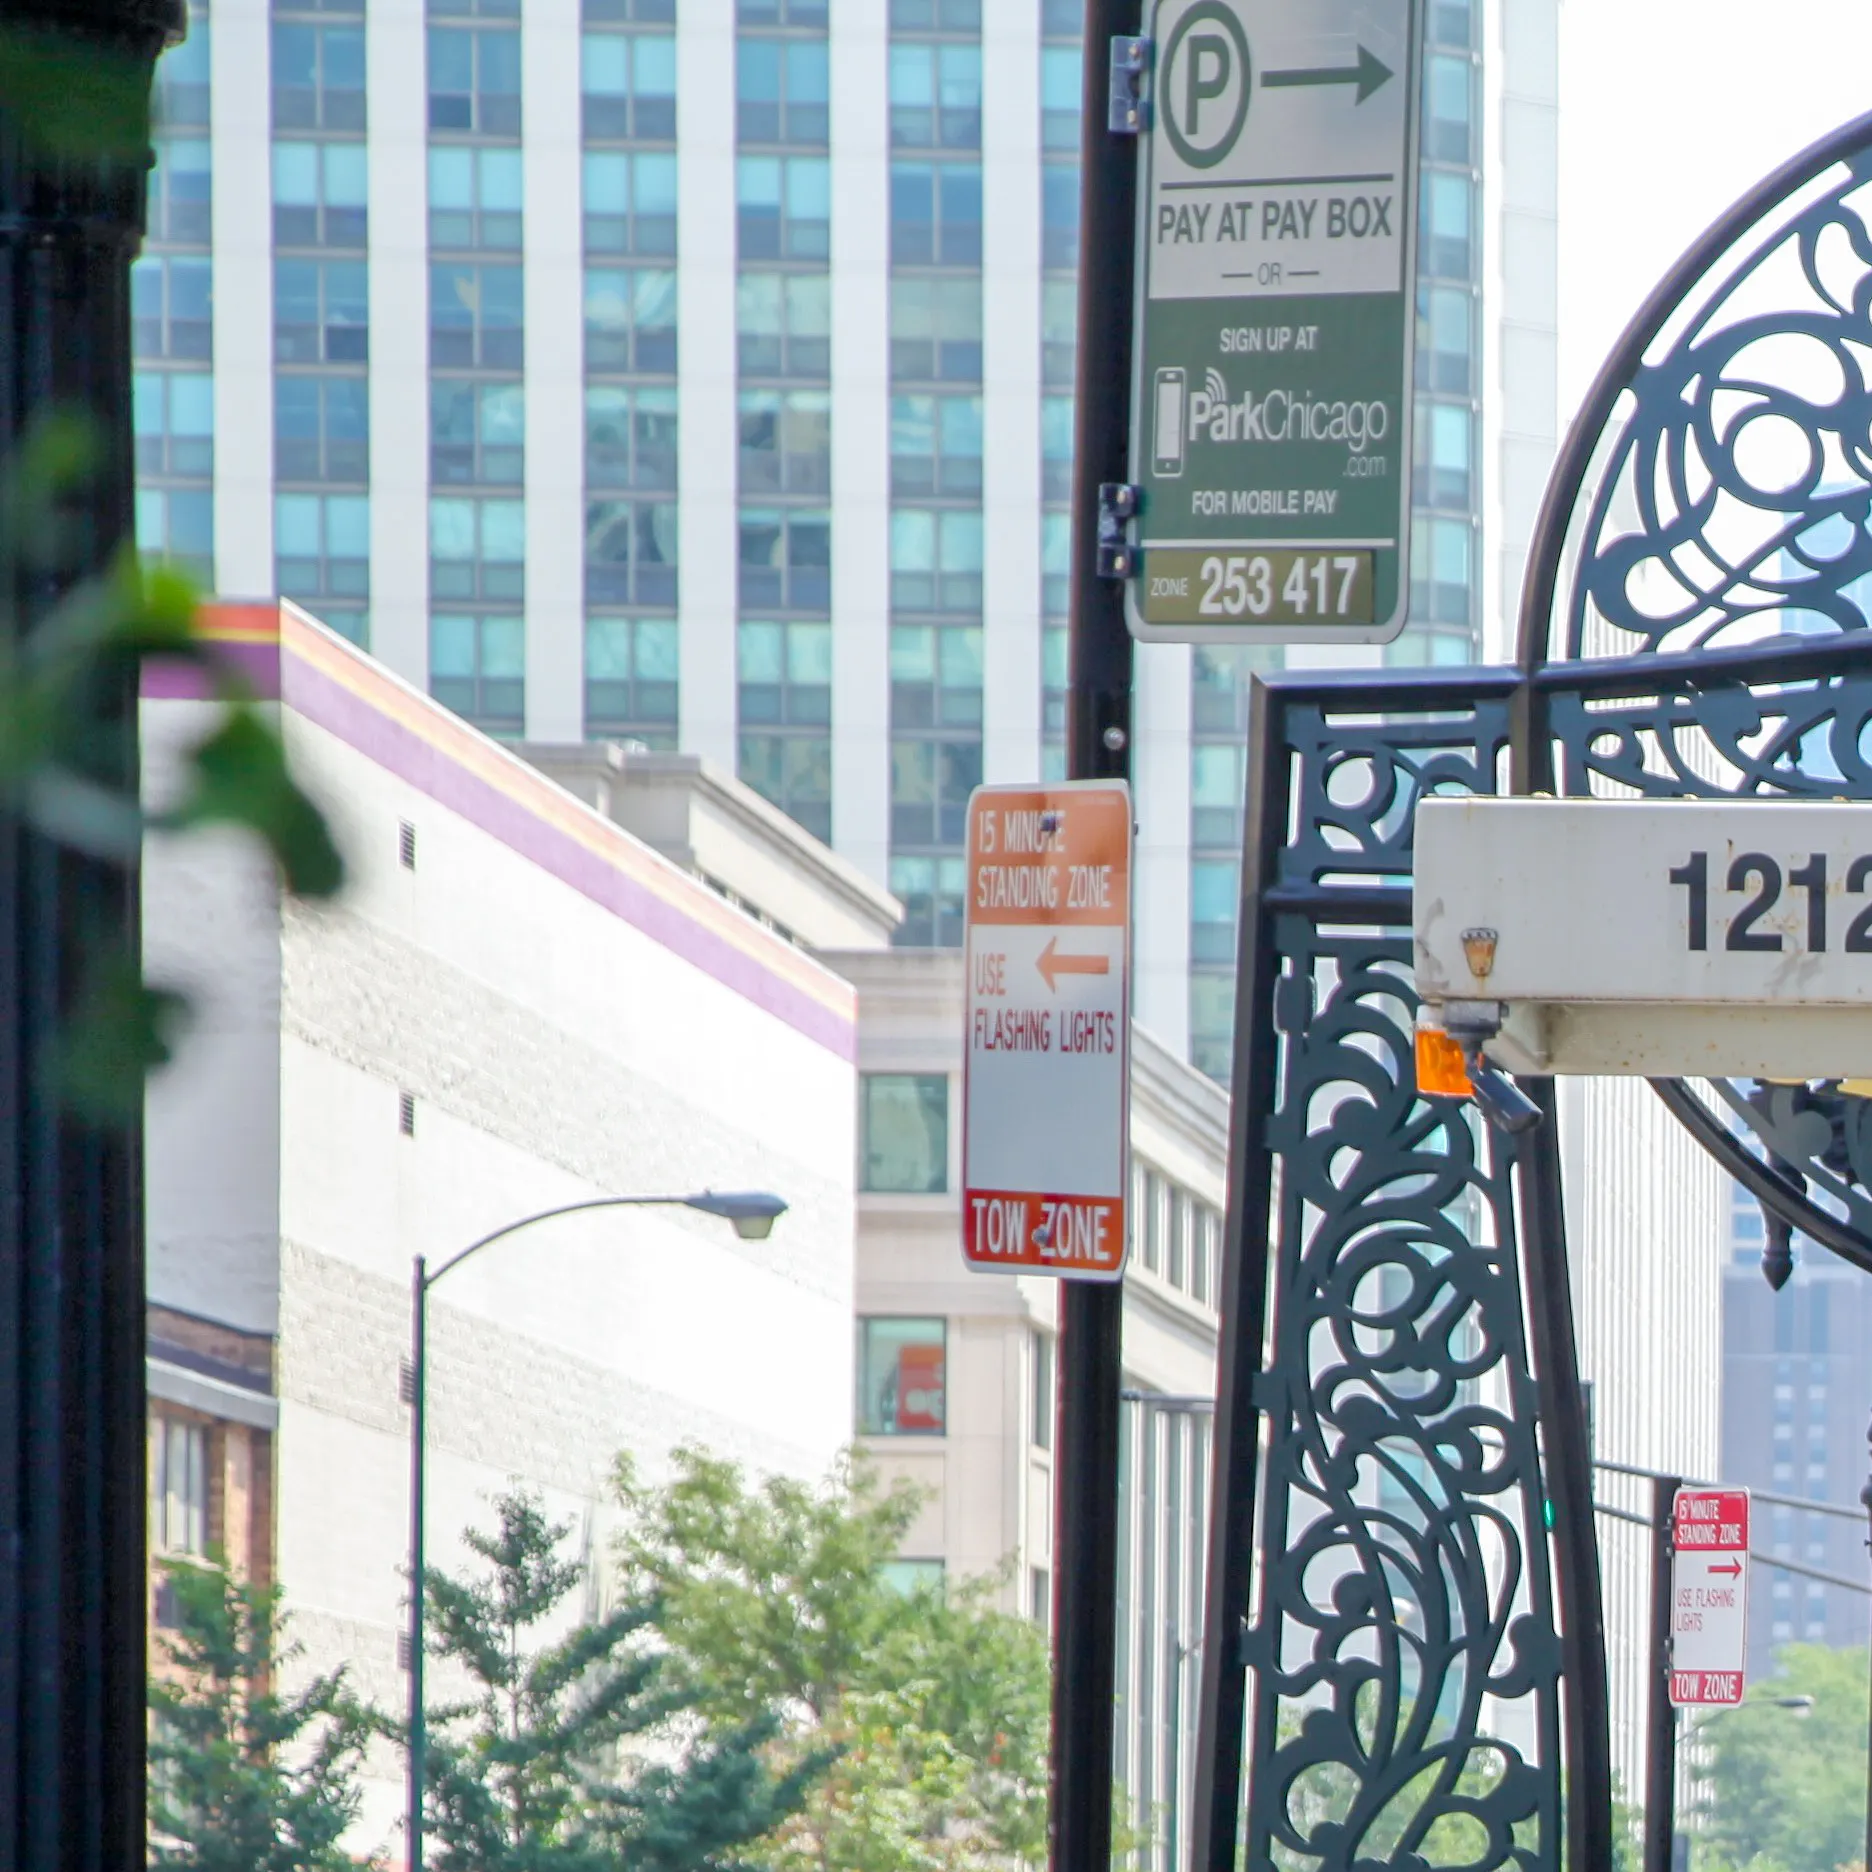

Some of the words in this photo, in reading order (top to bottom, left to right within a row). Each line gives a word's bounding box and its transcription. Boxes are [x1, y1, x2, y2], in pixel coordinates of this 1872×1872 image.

[1158, 203, 1210, 244] PAY
[1216, 202, 1254, 242] AT
[1262, 199, 1318, 240] PAY
[1327, 196, 1393, 238] BOX
[1257, 263, 1283, 286] OR
[1220, 328, 1261, 353] SIGN
[1266, 327, 1291, 351] UP
[1294, 325, 1318, 350] AT
[1188, 389, 1389, 453] ParkChicago
[1343, 455, 1386, 477] .com
[1192, 492, 1226, 514] FOR
[1231, 491, 1299, 514] MOBILE
[1303, 490, 1338, 514] PAY
[1151, 578, 1188, 598] ZONE
[1199, 557, 1272, 616] 253
[1283, 557, 1359, 614] 417
[979, 811, 995, 854] 15
[977, 866, 1058, 909] STANDING
[1067, 865, 1112, 909] ZONE
[976, 953, 1006, 997] USE
[974, 1009, 1050, 1053] FLASHING
[1060, 1011, 1115, 1054] LIGHTS
[972, 1199, 1026, 1255] TOW
[1034, 1203, 1112, 1260] ZONE
[1690, 1499, 1720, 1520] MINUTE
[1678, 1523, 1716, 1544] STANDING
[1719, 1523, 1742, 1544] ZONE
[1677, 1588, 1692, 1608] USE
[1696, 1588, 1735, 1608] FLASHING
[1676, 1613, 1703, 1632] LIGHTS
[1675, 1674, 1700, 1700] TOW
[1704, 1674, 1737, 1701] ZONE
